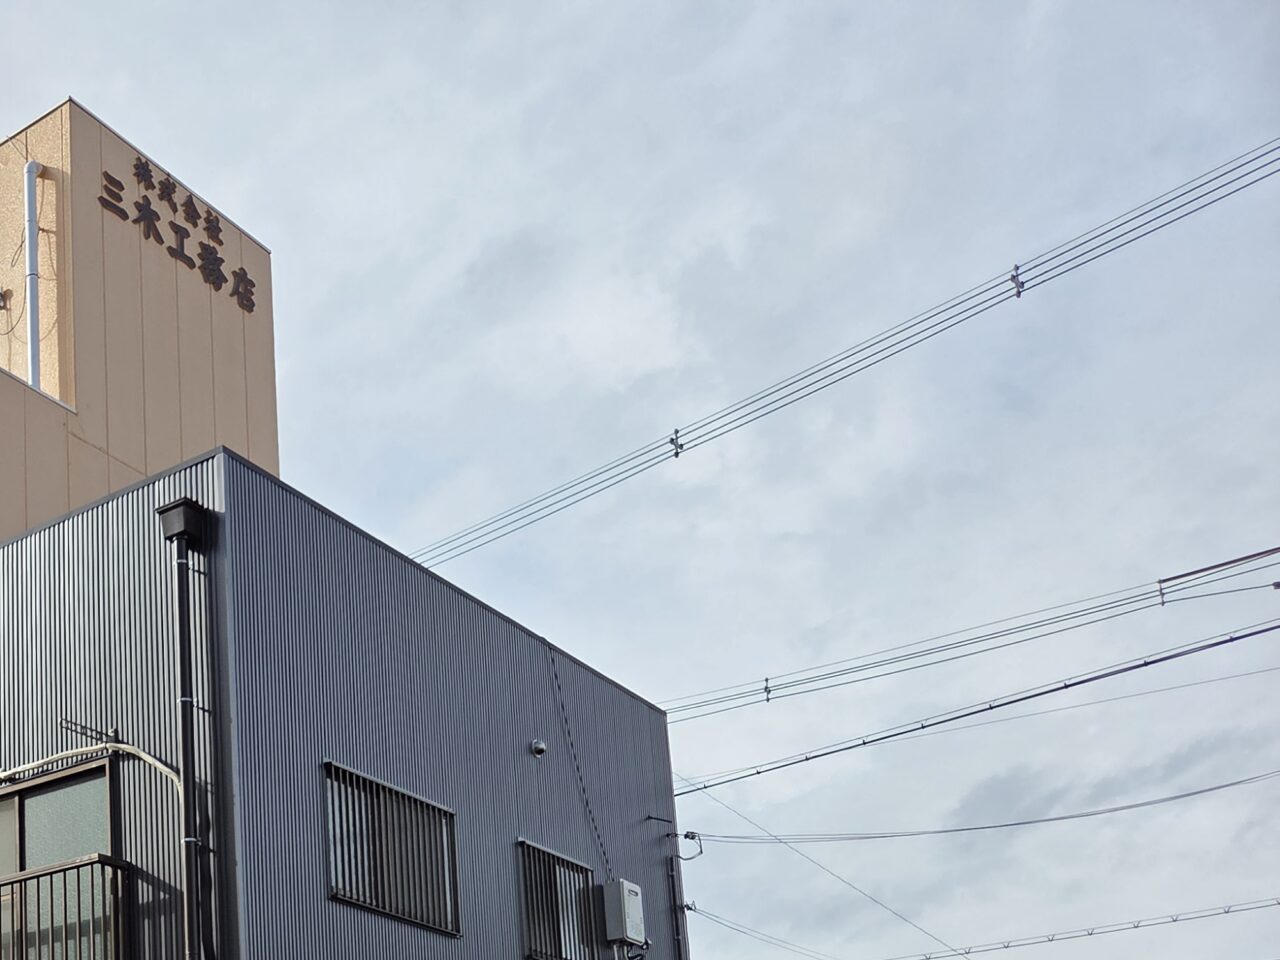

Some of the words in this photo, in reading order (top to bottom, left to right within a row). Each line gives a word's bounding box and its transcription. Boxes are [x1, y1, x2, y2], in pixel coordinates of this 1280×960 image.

[97, 170, 255, 313] 三木工務店
